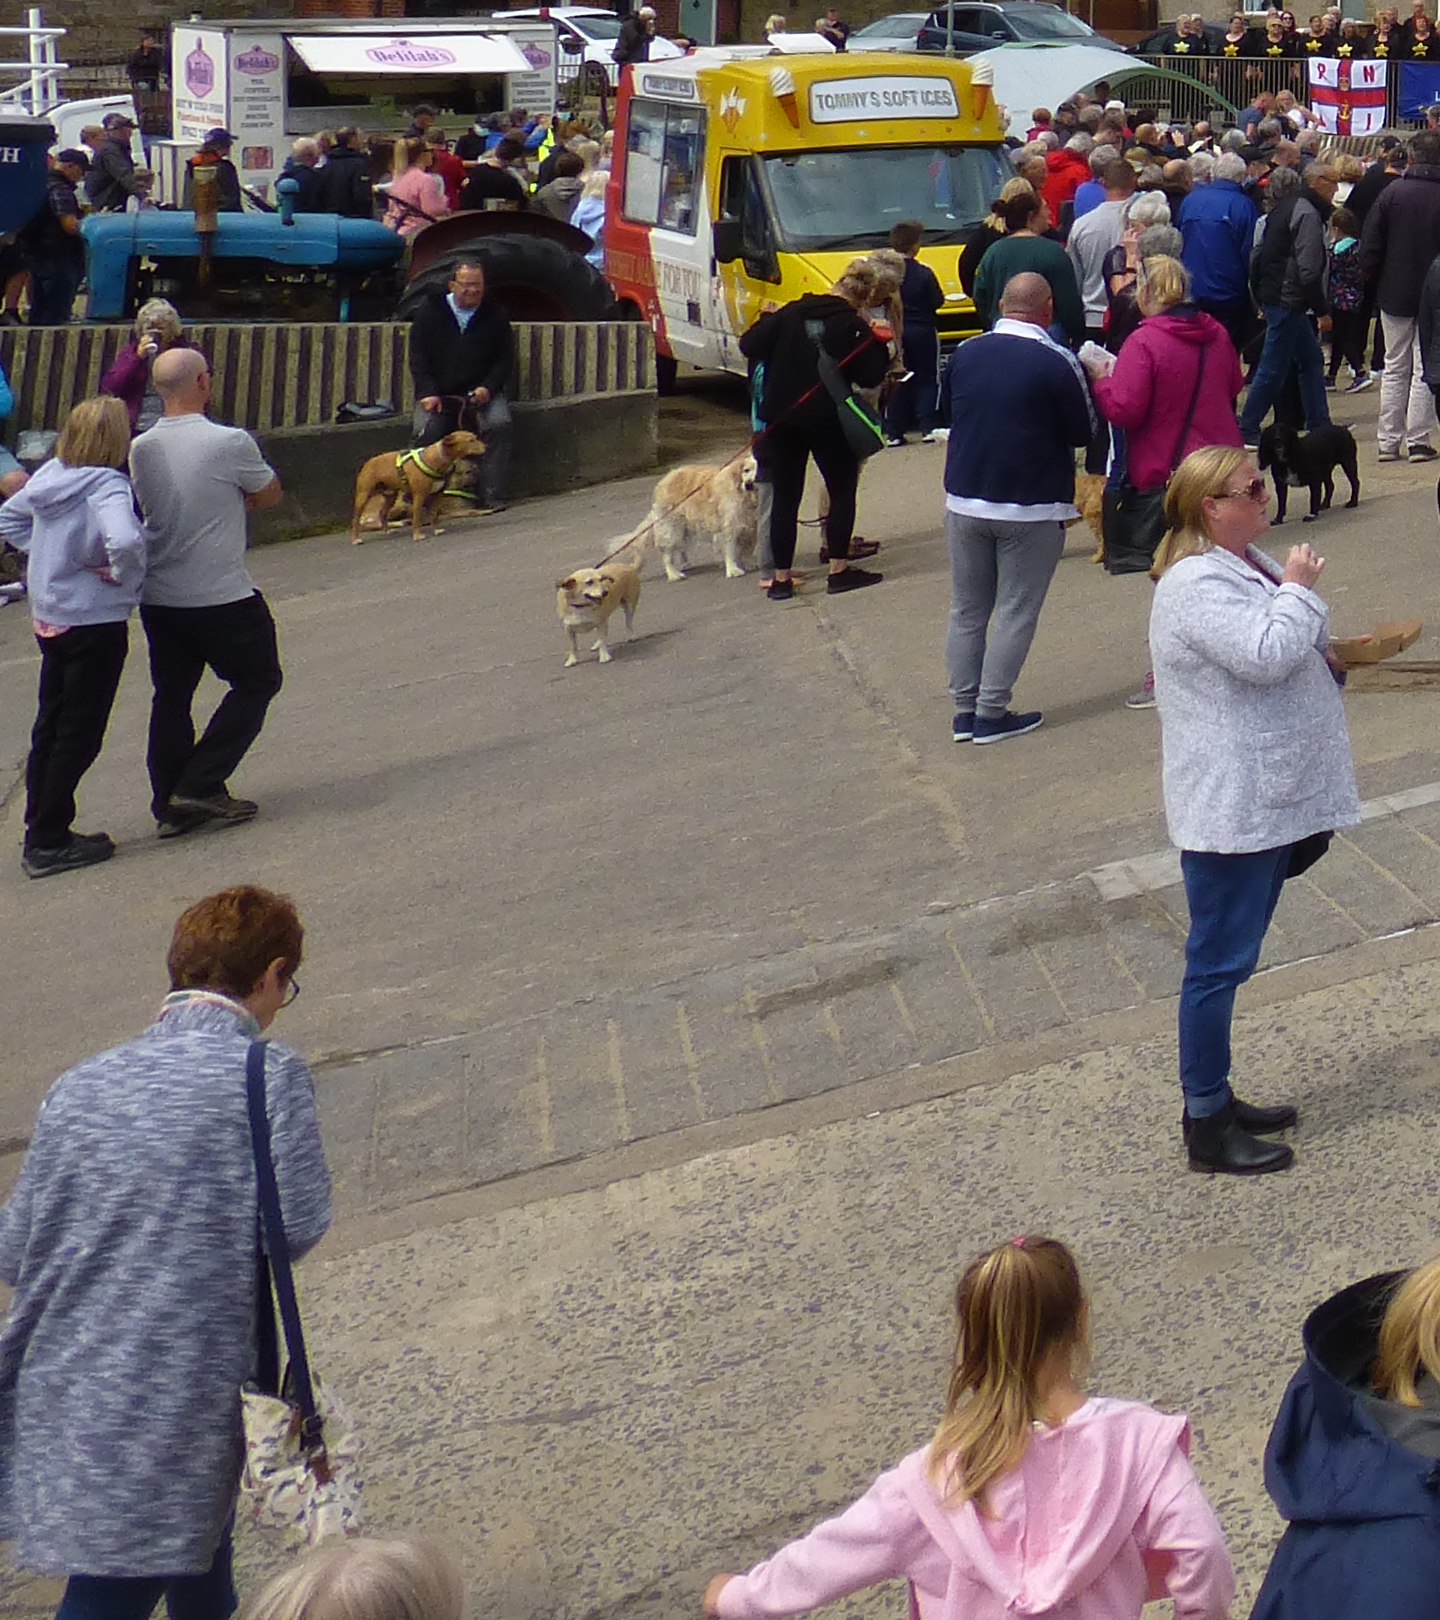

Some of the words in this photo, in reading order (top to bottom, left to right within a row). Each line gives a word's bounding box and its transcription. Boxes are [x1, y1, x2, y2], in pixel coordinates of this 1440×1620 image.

[374, 49, 450, 63] Delilah's
[815, 91, 881, 111] TOMMY'S
[883, 90, 919, 107] SOFT
[921, 90, 953, 107] ICES
